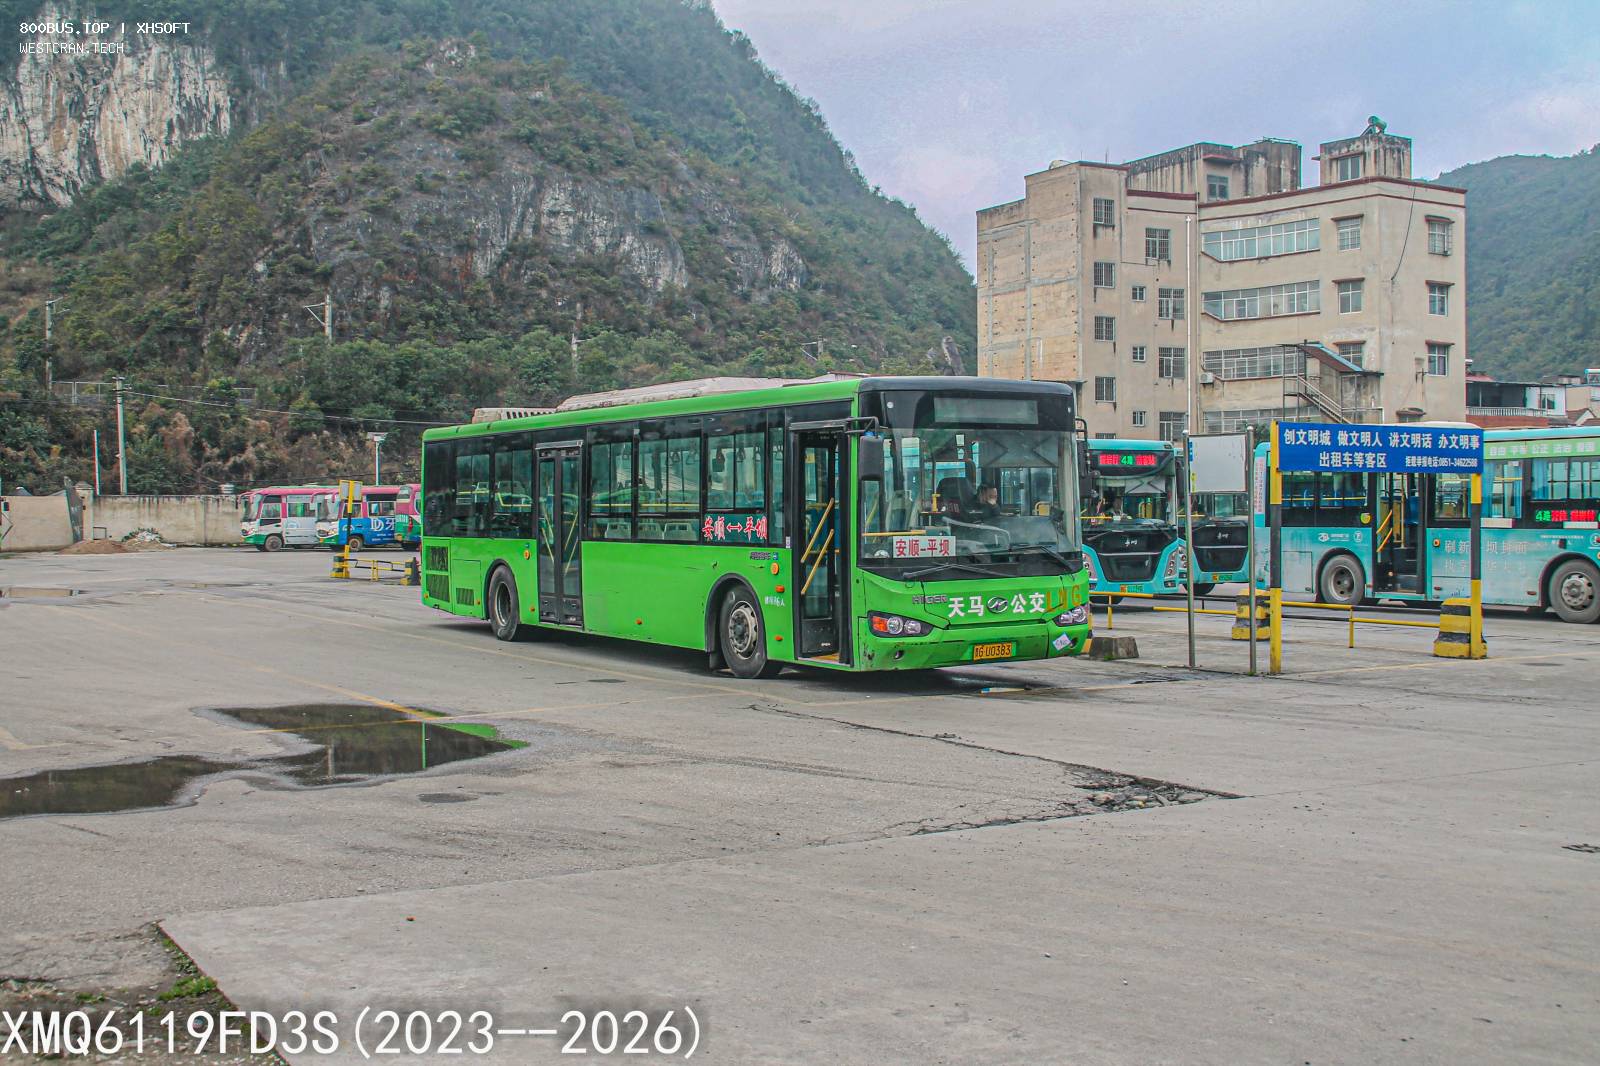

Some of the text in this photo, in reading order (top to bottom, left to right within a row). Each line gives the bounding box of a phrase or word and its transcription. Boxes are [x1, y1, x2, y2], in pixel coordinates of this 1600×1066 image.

[1284, 429, 1480, 450] 创文明城 做文明人 讲文明话 办文明事
[1319, 452, 1387, 468] 出租车等客区
[948, 595, 984, 618] 天马
[1010, 592, 1046, 613] 公交
